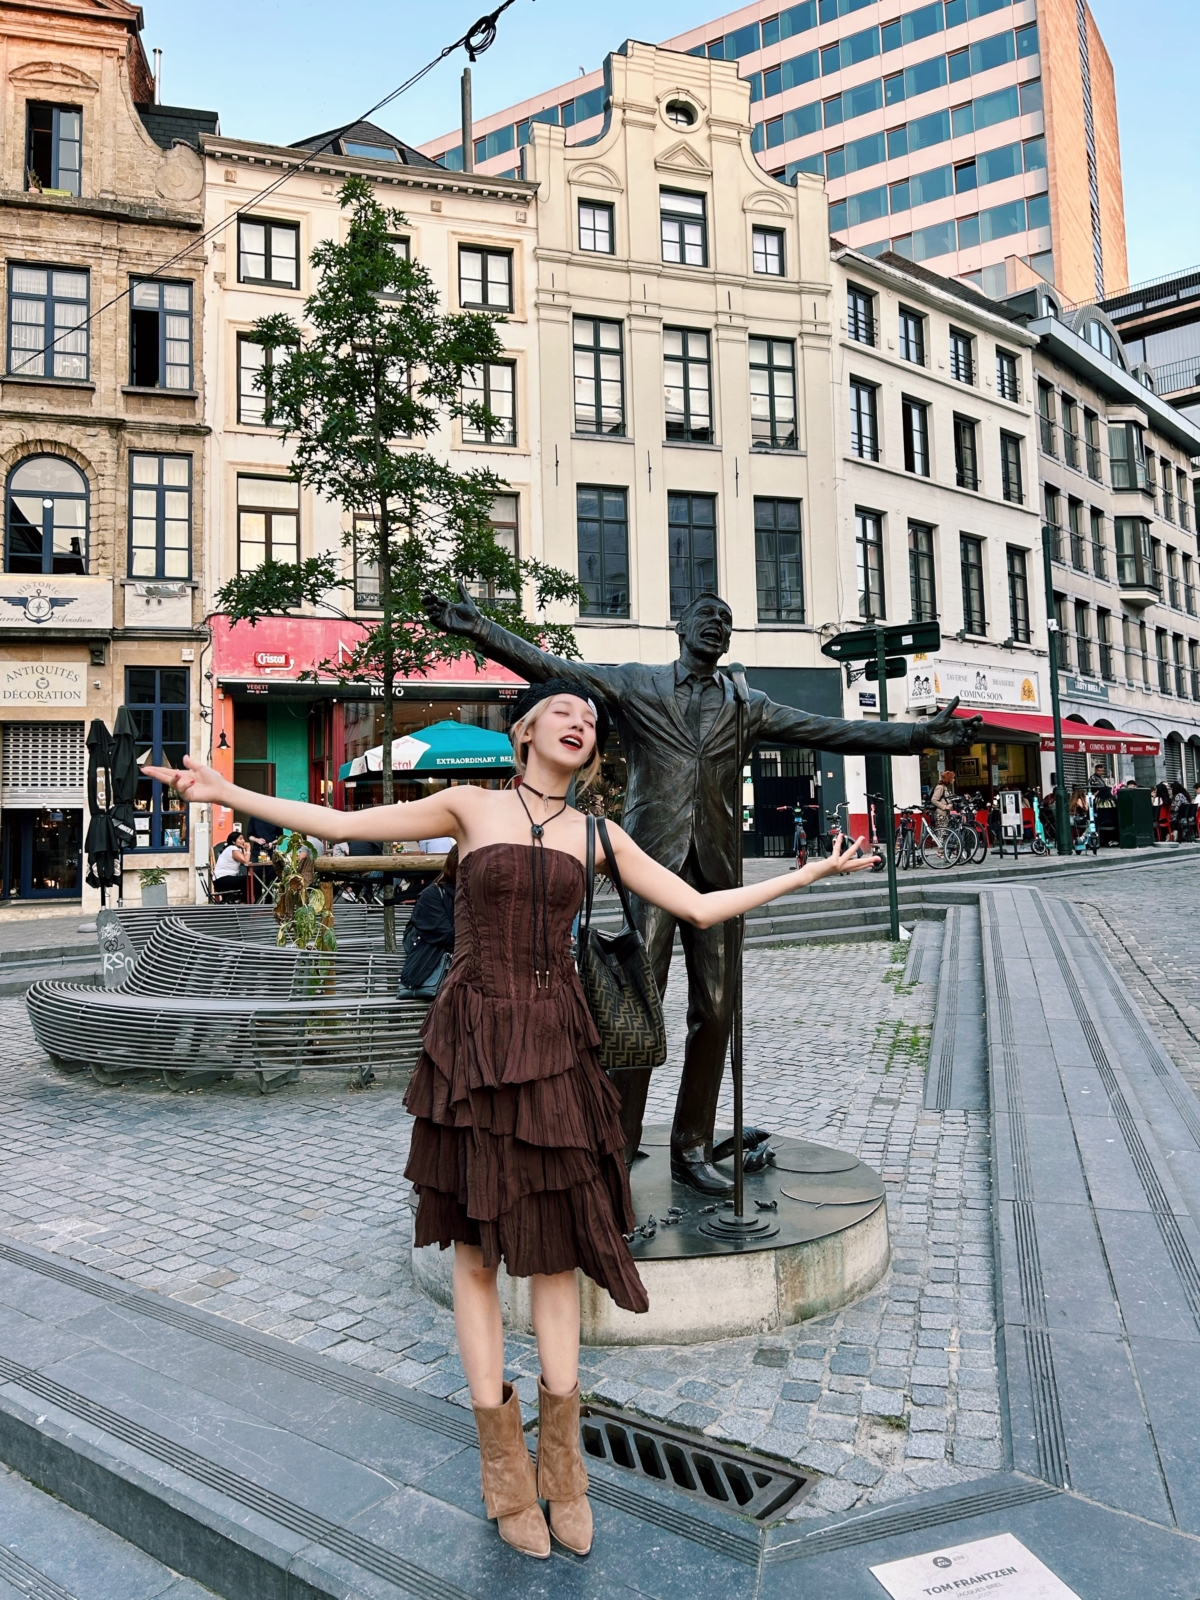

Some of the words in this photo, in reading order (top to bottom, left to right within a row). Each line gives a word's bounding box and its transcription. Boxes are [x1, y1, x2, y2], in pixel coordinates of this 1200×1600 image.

[17, 581, 61, 596] HISTORIC
[0, 612, 26, 623] arine
[51, 613, 93, 623] Aviation
[257, 652, 286, 665] Cristal
[6, 665, 80, 683] ANTIQUITÉS
[946, 673, 968, 682] TAVERNE
[992, 678, 1015, 688] BRASSERIE
[1074, 680, 1088, 691] TASTY
[3, 689, 81, 700] DÉCORATION
[959, 689, 986, 700] COMING
[986, 692, 1003, 701] SOON
[436, 756, 497, 765] EXTRAORDINARY
[922, 1583, 954, 1597] TOM
[952, 1566, 1018, 1588] FRANTZEN
[956, 1586, 987, 1598] JACQUES
[985, 1581, 1004, 1591] BREL
